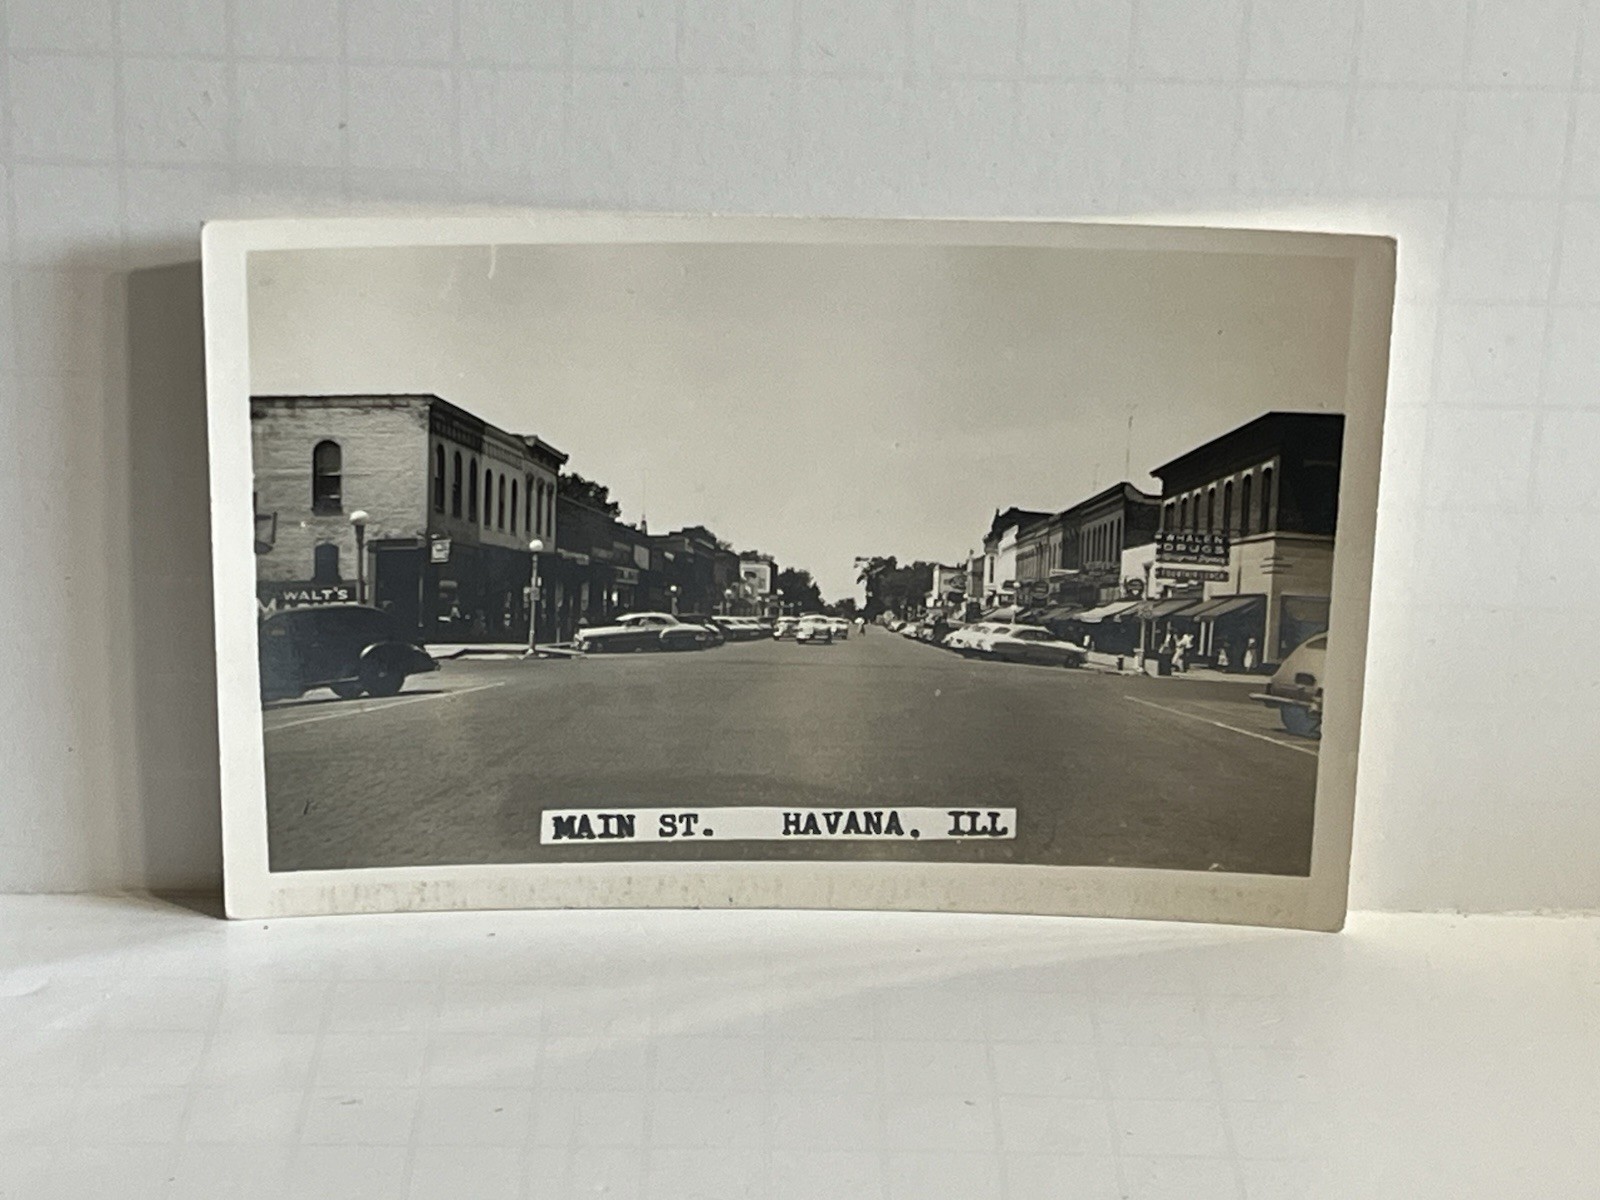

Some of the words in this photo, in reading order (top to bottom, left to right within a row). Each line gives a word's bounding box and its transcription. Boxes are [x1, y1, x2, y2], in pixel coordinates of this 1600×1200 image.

[1163, 543, 1225, 554] DRUGS
[283, 586, 348, 600] WALT'S
[551, 813, 637, 840] MAIN
[658, 813, 714, 838] ST.
[947, 810, 1009, 837] ILL
